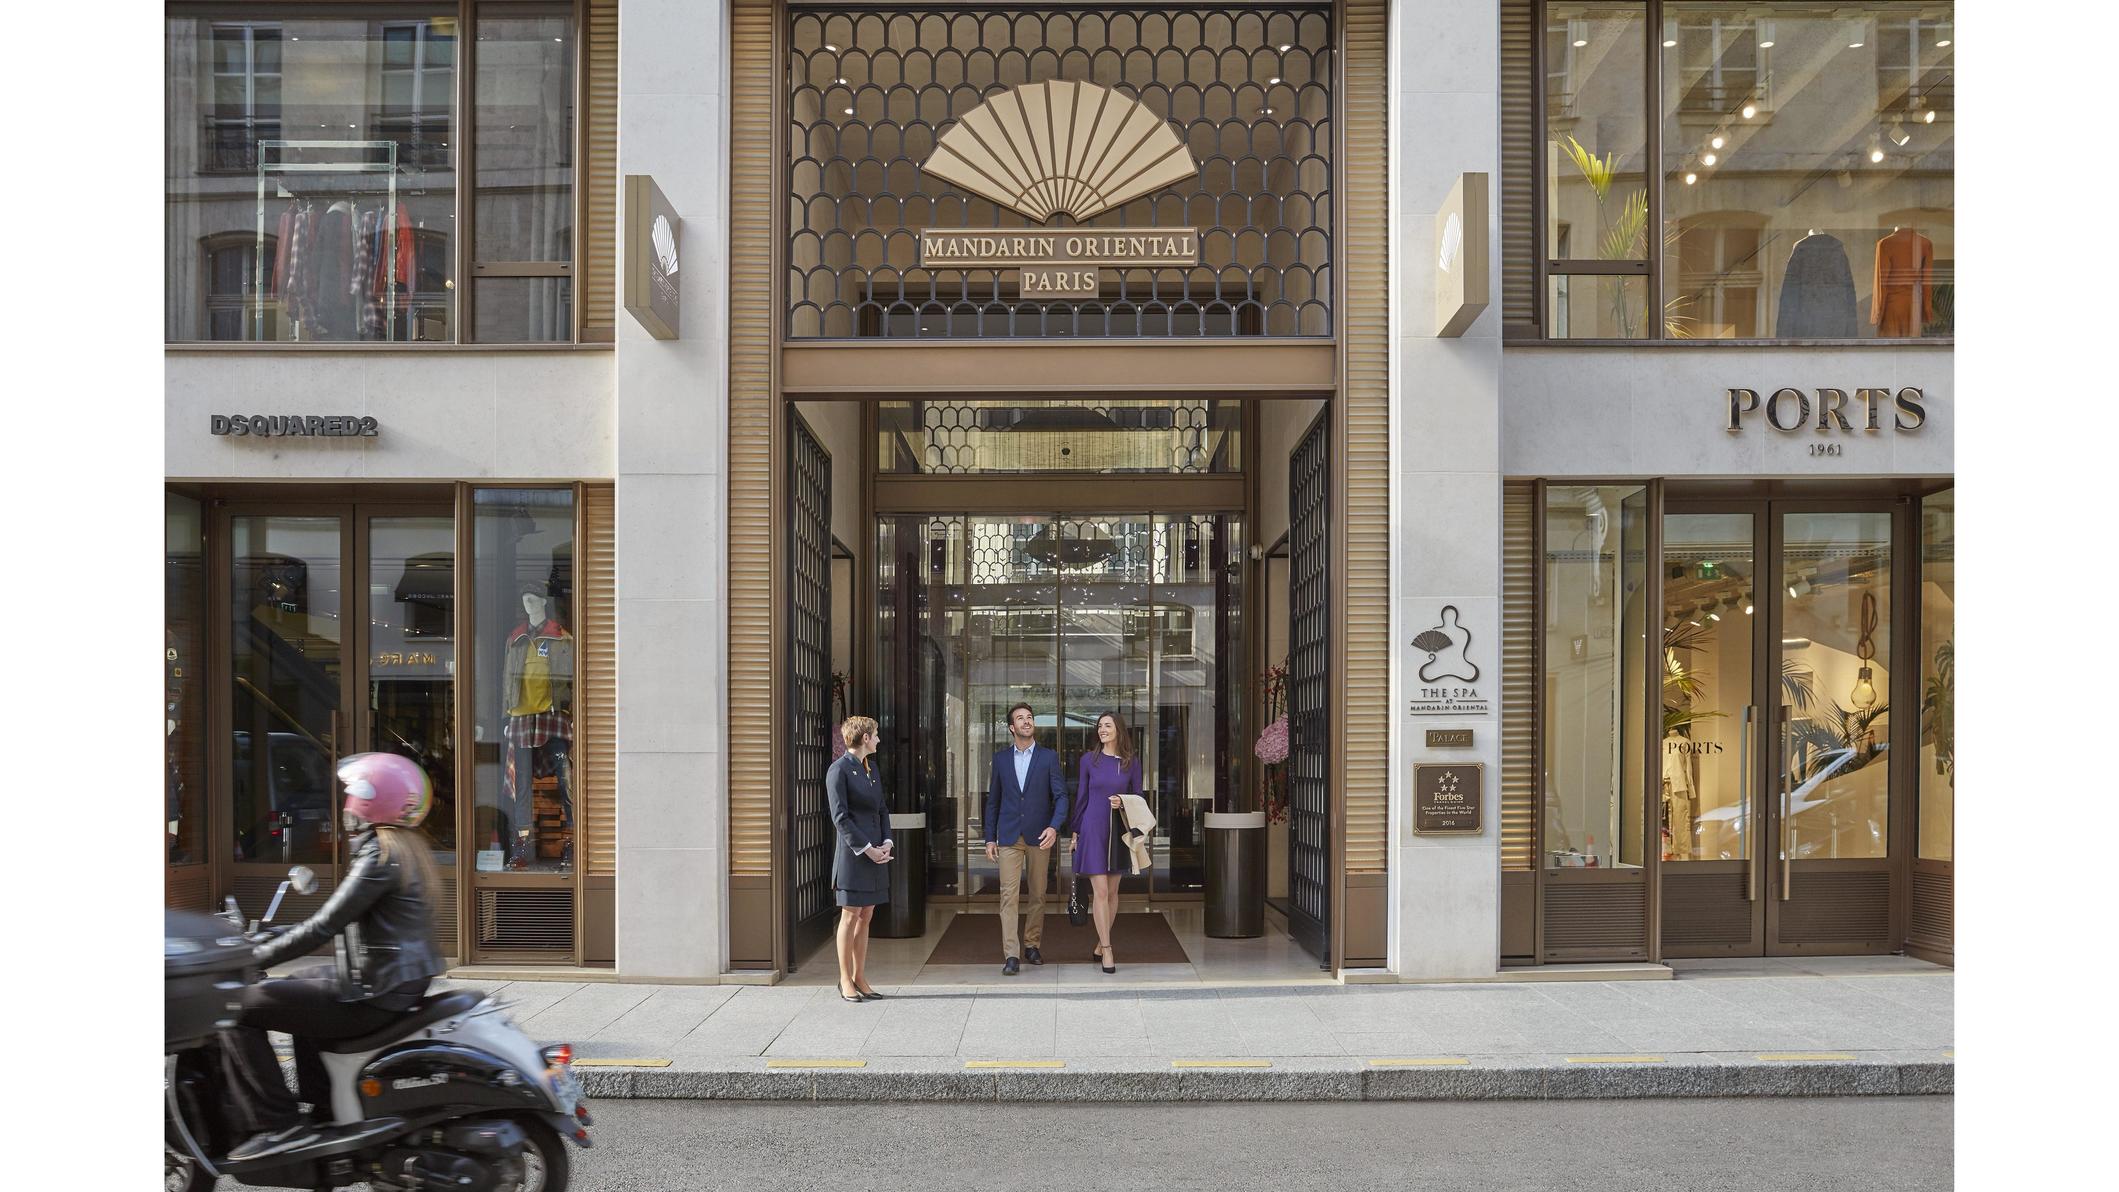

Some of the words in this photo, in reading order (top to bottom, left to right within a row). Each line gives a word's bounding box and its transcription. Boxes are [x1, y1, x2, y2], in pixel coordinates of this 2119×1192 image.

[924, 237, 1054, 258] MANDARIN
[1066, 236, 1195, 258] ORIENTAL
[1023, 271, 1095, 292] PARIS
[1727, 387, 1926, 432] PORTS
[211, 414, 379, 437] DSQUARED2
[1809, 443, 1842, 456] 1961
[1421, 688, 1447, 698] THE
[1453, 687, 1478, 698] SPA
[1668, 742, 1723, 755] PORTS
[1434, 792, 1464, 801] Forbes
